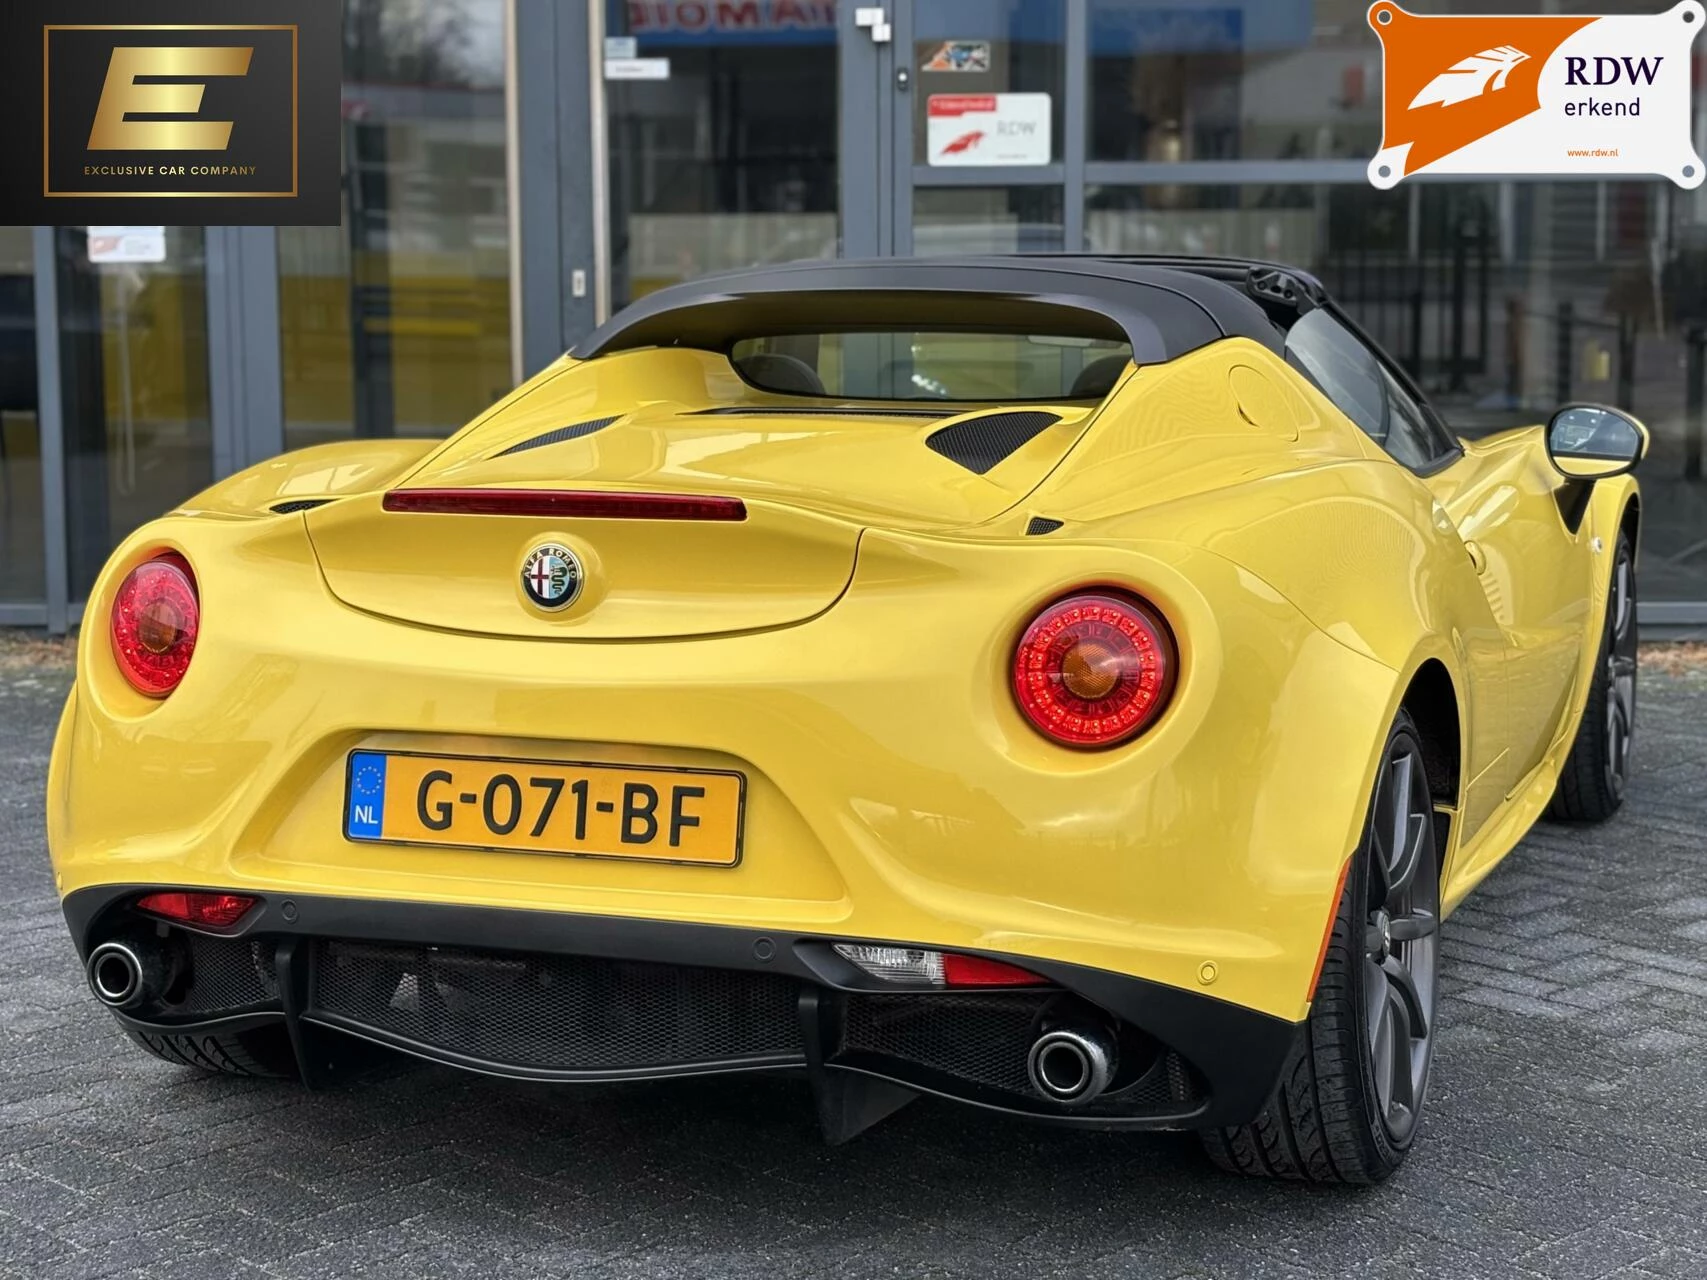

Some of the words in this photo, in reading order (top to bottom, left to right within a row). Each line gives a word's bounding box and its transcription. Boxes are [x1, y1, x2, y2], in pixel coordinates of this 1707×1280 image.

[996, 119, 1037, 136] RDW
[524, 551, 543, 578] ALFA
[548, 548, 577, 579] ROMEO
[354, 804, 379, 825] NL
[416, 769, 706, 847] G-071-BF
